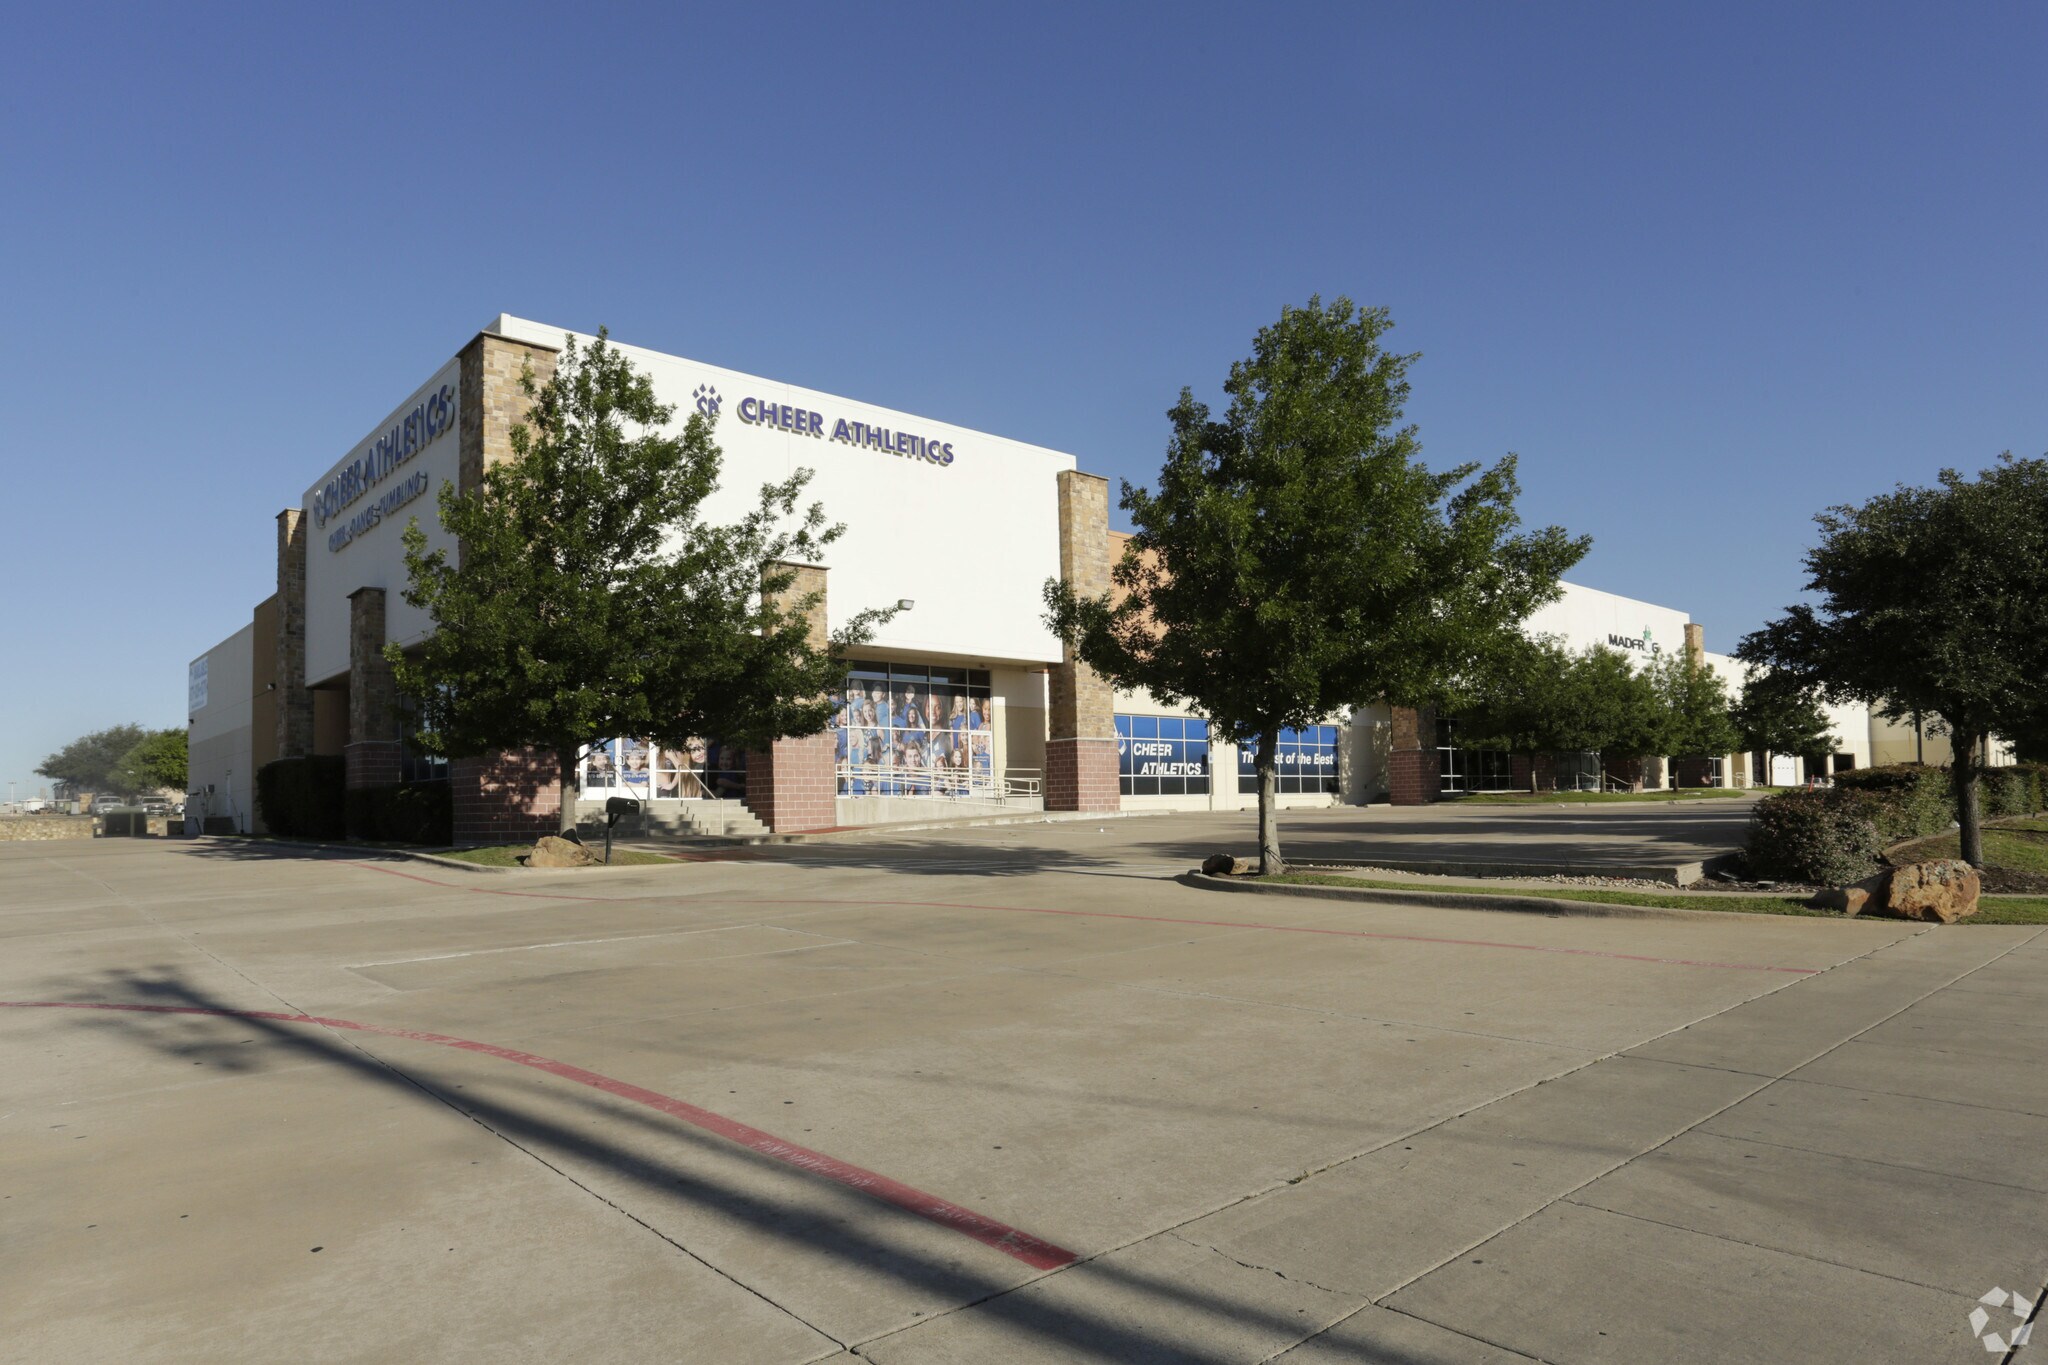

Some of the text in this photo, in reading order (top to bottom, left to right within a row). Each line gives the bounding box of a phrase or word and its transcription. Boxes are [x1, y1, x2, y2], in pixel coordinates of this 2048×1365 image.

[738, 397, 955, 466] CHEER ATHLETICS
[324, 457, 366, 518] CHEER
[365, 384, 455, 485] ATHLETICS
[1133, 742, 1173, 757] CHEER
[1286, 752, 1296, 764] of
[1297, 753, 1311, 765] the
[1314, 753, 1334, 765] Best
[1140, 762, 1202, 775] ATHLETICS
